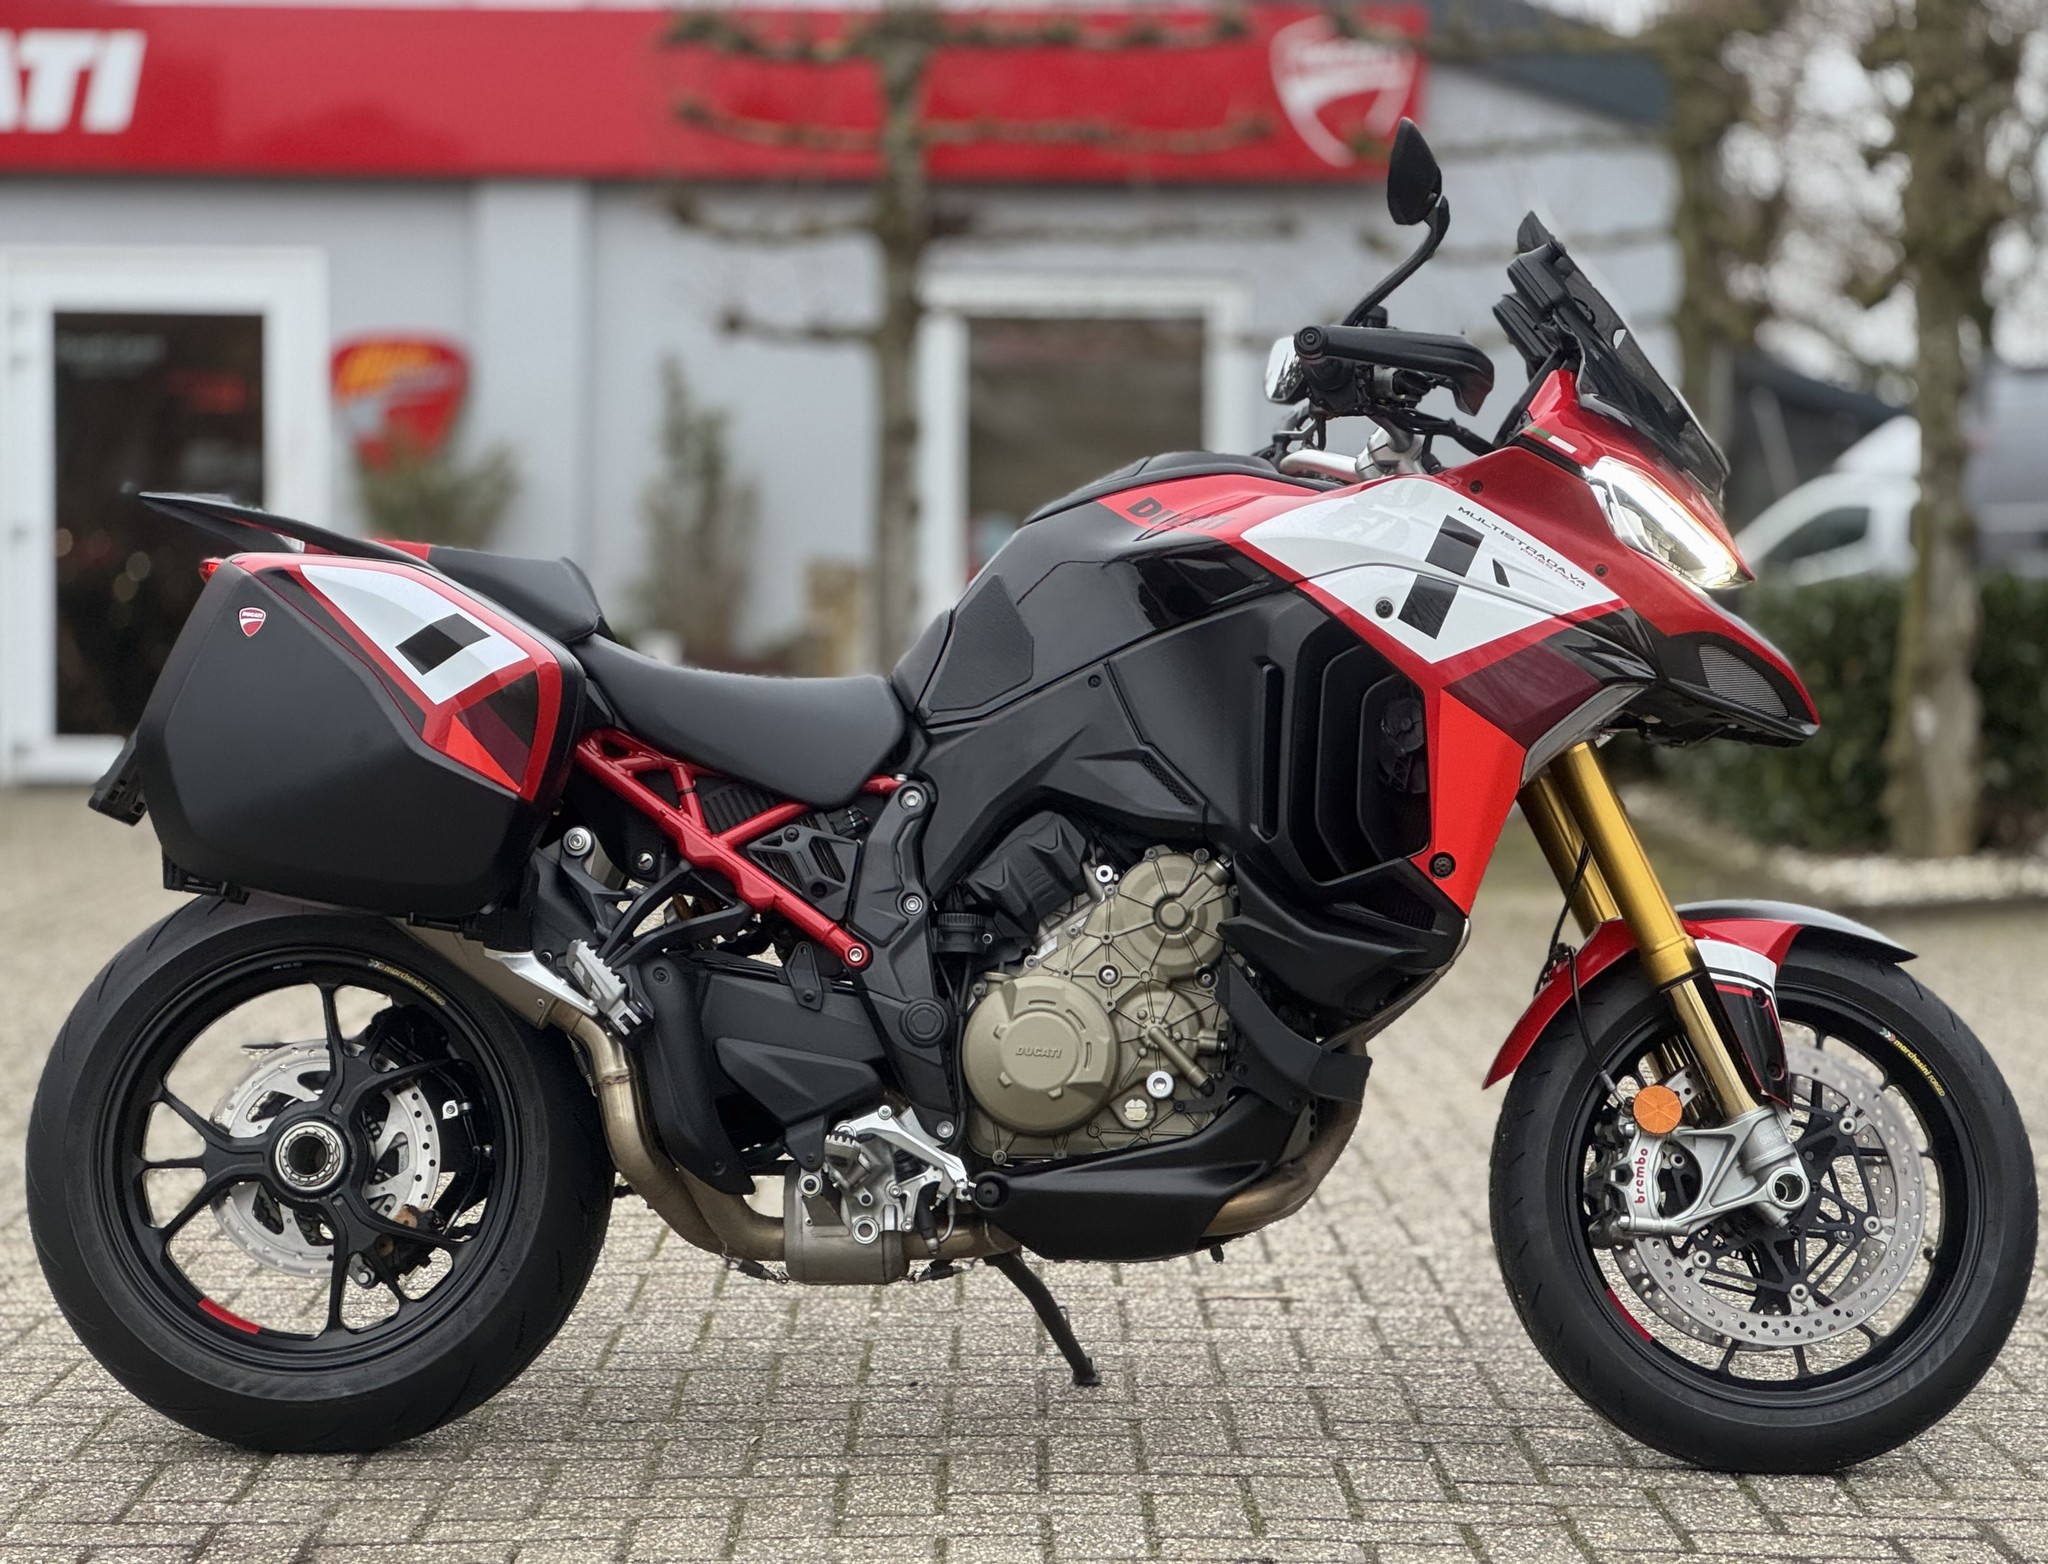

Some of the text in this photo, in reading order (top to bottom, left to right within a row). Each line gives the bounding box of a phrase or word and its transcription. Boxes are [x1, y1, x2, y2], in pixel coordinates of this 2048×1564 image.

[1457, 506, 1566, 574] MULTISTRADA
[1015, 1046, 1063, 1059] DUCATI
[1893, 1039, 1932, 1076] marchesini
[1634, 1148, 1648, 1204] brembo
